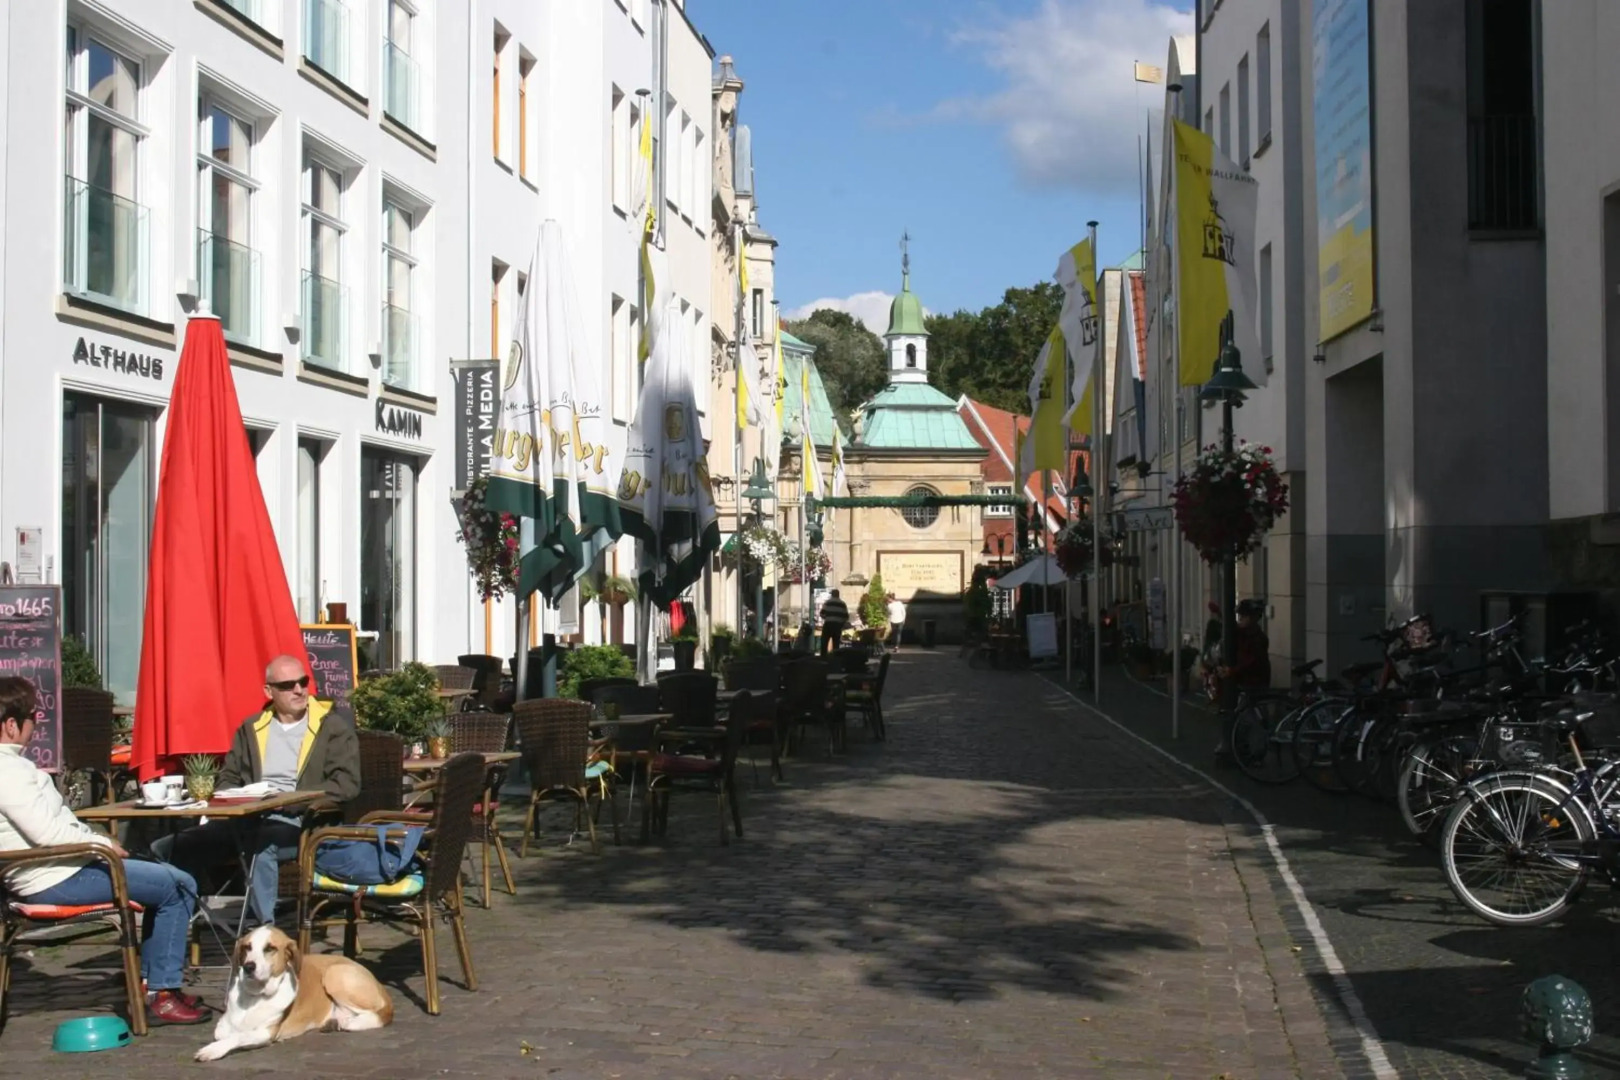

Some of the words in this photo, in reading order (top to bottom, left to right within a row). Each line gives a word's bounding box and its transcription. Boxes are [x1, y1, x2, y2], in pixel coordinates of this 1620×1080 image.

[72, 336, 163, 380] ALTHAUS
[465, 371, 474, 416] PIZZERIA
[478, 370, 494, 431] MEDIA
[375, 400, 422, 440] KAMIN
